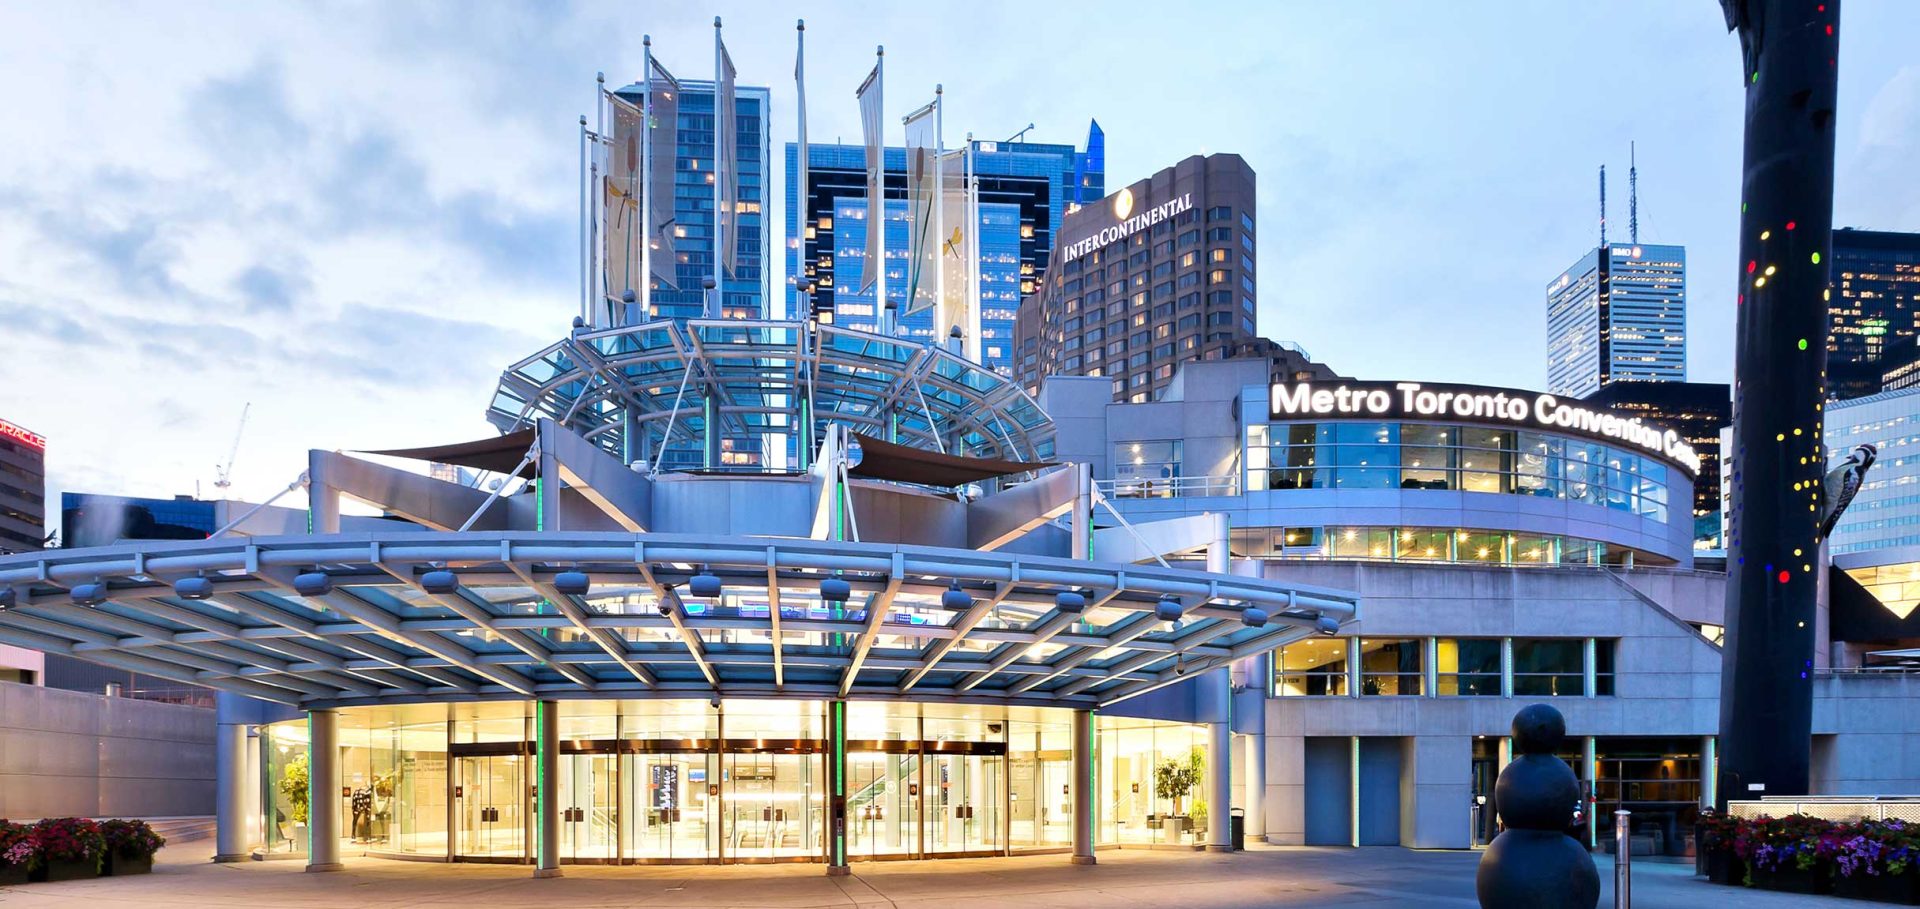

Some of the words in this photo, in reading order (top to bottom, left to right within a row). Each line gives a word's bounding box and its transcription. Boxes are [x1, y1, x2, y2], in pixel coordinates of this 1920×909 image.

[1612, 247, 1631, 256] BMO
[1271, 383, 1390, 413] Metro
[1396, 383, 1528, 420] Toronto
[1535, 394, 1662, 451] Convention
